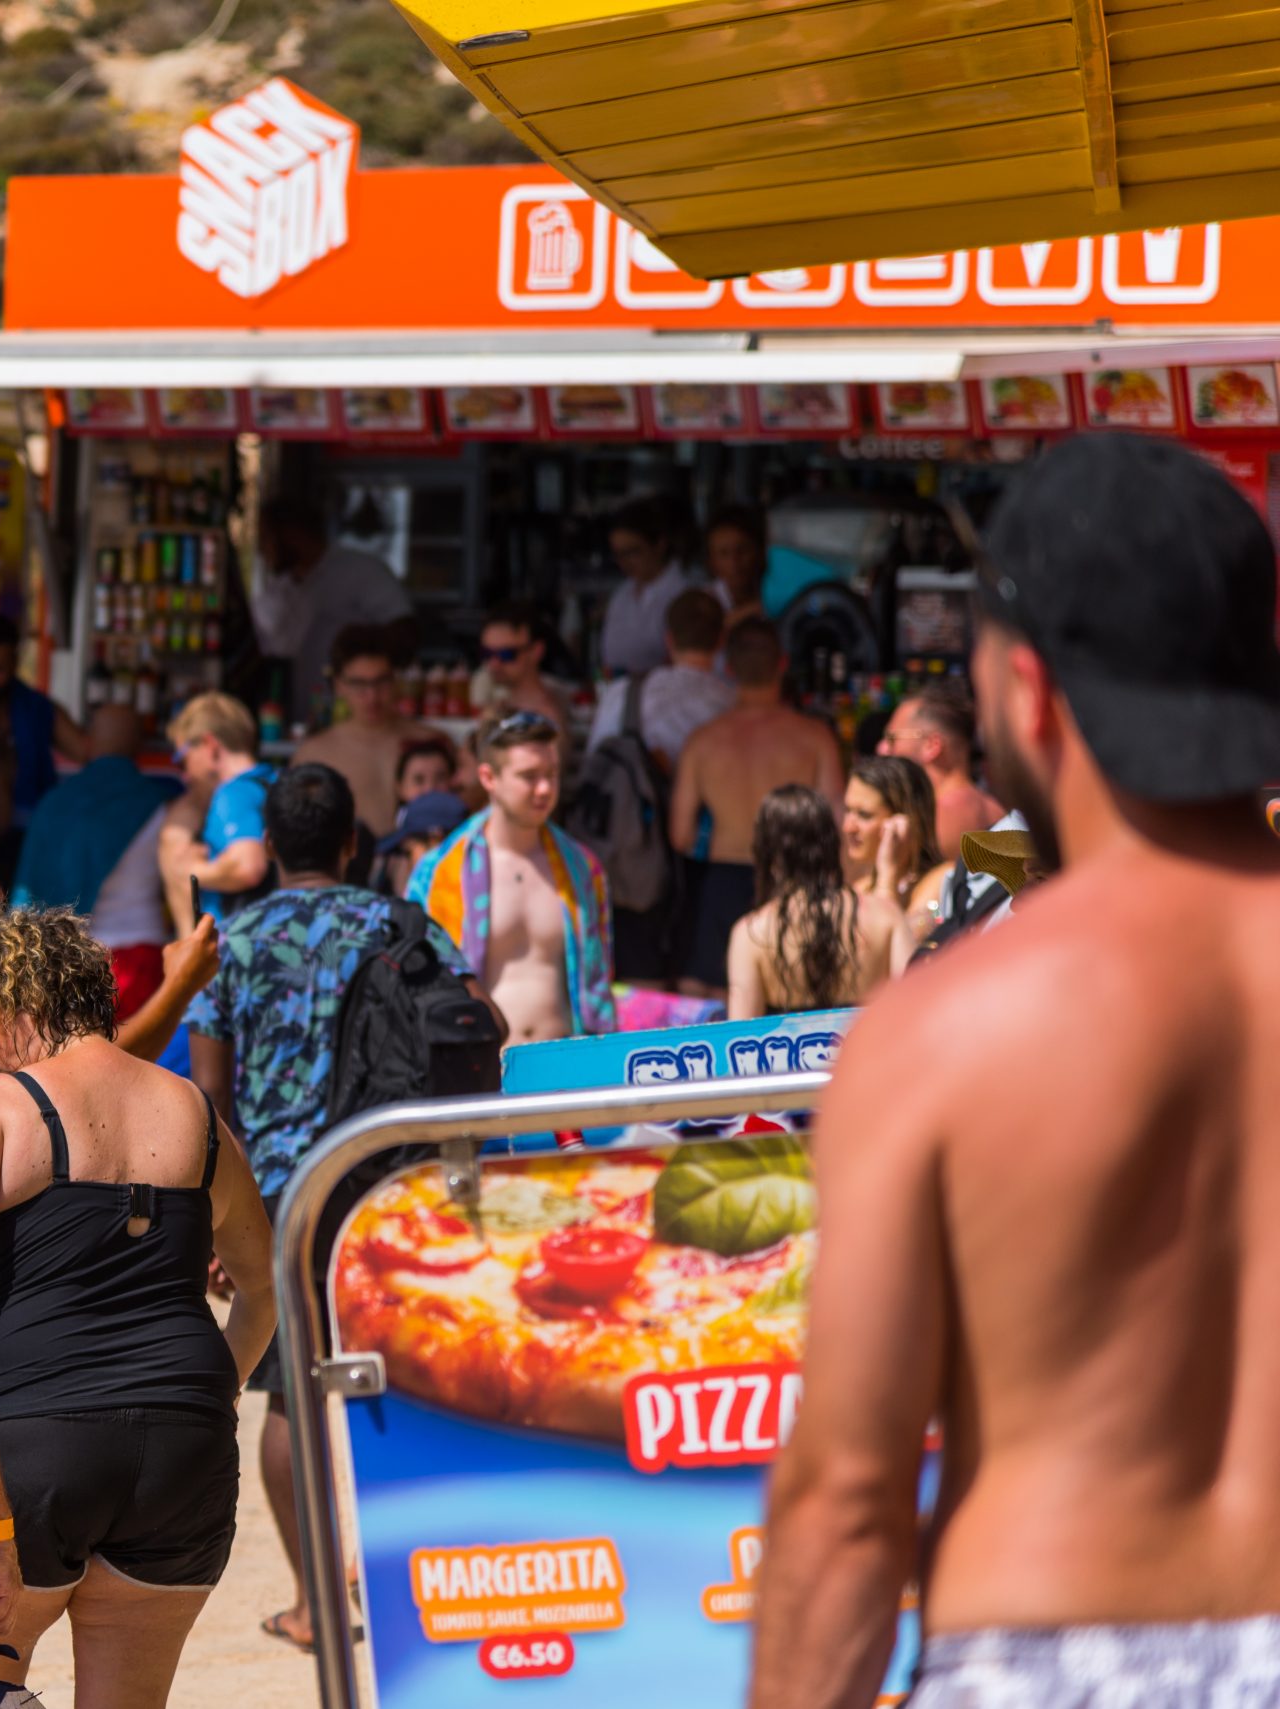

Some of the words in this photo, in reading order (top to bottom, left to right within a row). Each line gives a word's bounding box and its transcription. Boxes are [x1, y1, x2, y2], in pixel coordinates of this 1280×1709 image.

[177, 77, 352, 298] SNACK
[250, 135, 351, 297] BOX
[419, 1547, 618, 1601] MARGERITA
[431, 1611, 483, 1632] TOMATO
[489, 1641, 565, 1670] €6.50
